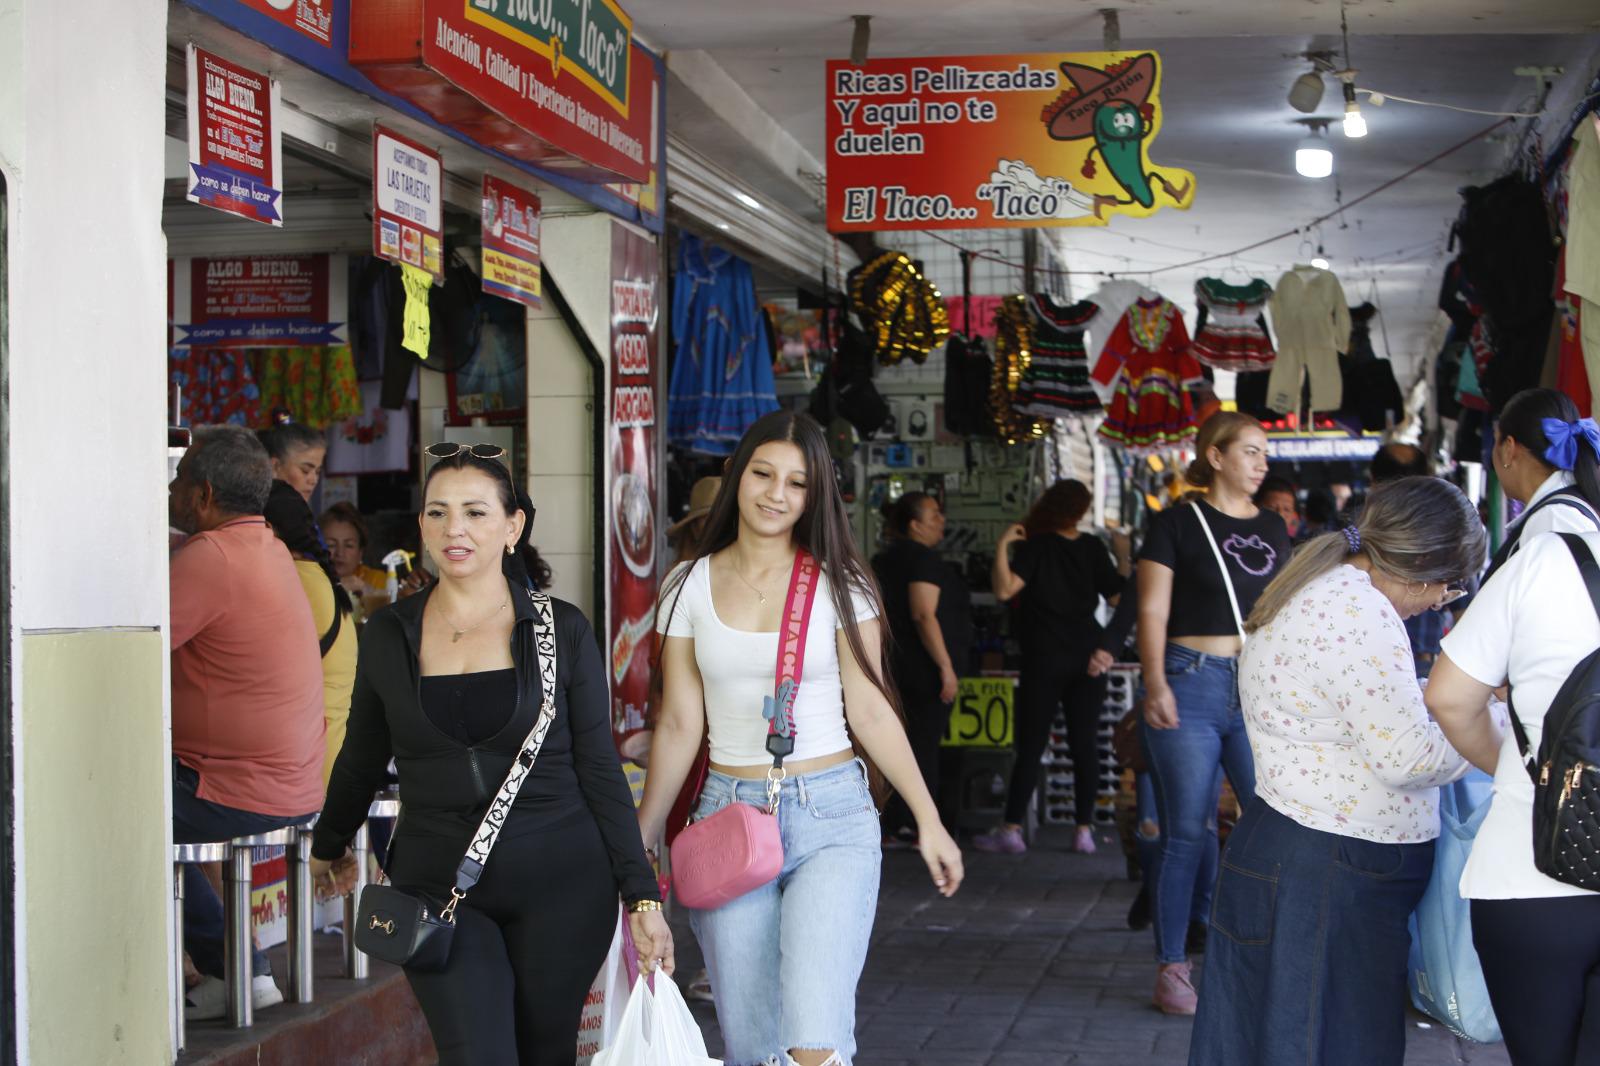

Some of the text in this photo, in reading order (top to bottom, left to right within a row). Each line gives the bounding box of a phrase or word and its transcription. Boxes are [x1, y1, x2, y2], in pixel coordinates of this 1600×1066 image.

[227, 70, 262, 91] preparando
[436, 16, 483, 74] Atención,
[486, 46, 520, 92] Calidad
[522, 71, 528, 98] y
[529, 72, 576, 124] Experiencia
[577, 102, 600, 138] hacen
[600, 116, 608, 143] la
[837, 67, 1056, 94] Ricas Pellizcadas
[206, 71, 263, 116] ALGO BUENO...
[1065, 72, 1144, 121] Taco Rajón
[838, 98, 996, 127] Y aqui no te
[837, 130, 923, 154] duelen
[245, 150, 264, 170] frescos
[201, 176, 219, 189] como
[221, 181, 228, 192] se
[252, 181, 271, 202] hacer
[387, 167, 431, 203] LAS TARJETAS
[844, 182, 1071, 221] El Taco... "Taco"
[207, 260, 313, 278] ALGO BUENO...
[193, 323, 325, 337] como se deben hacer
